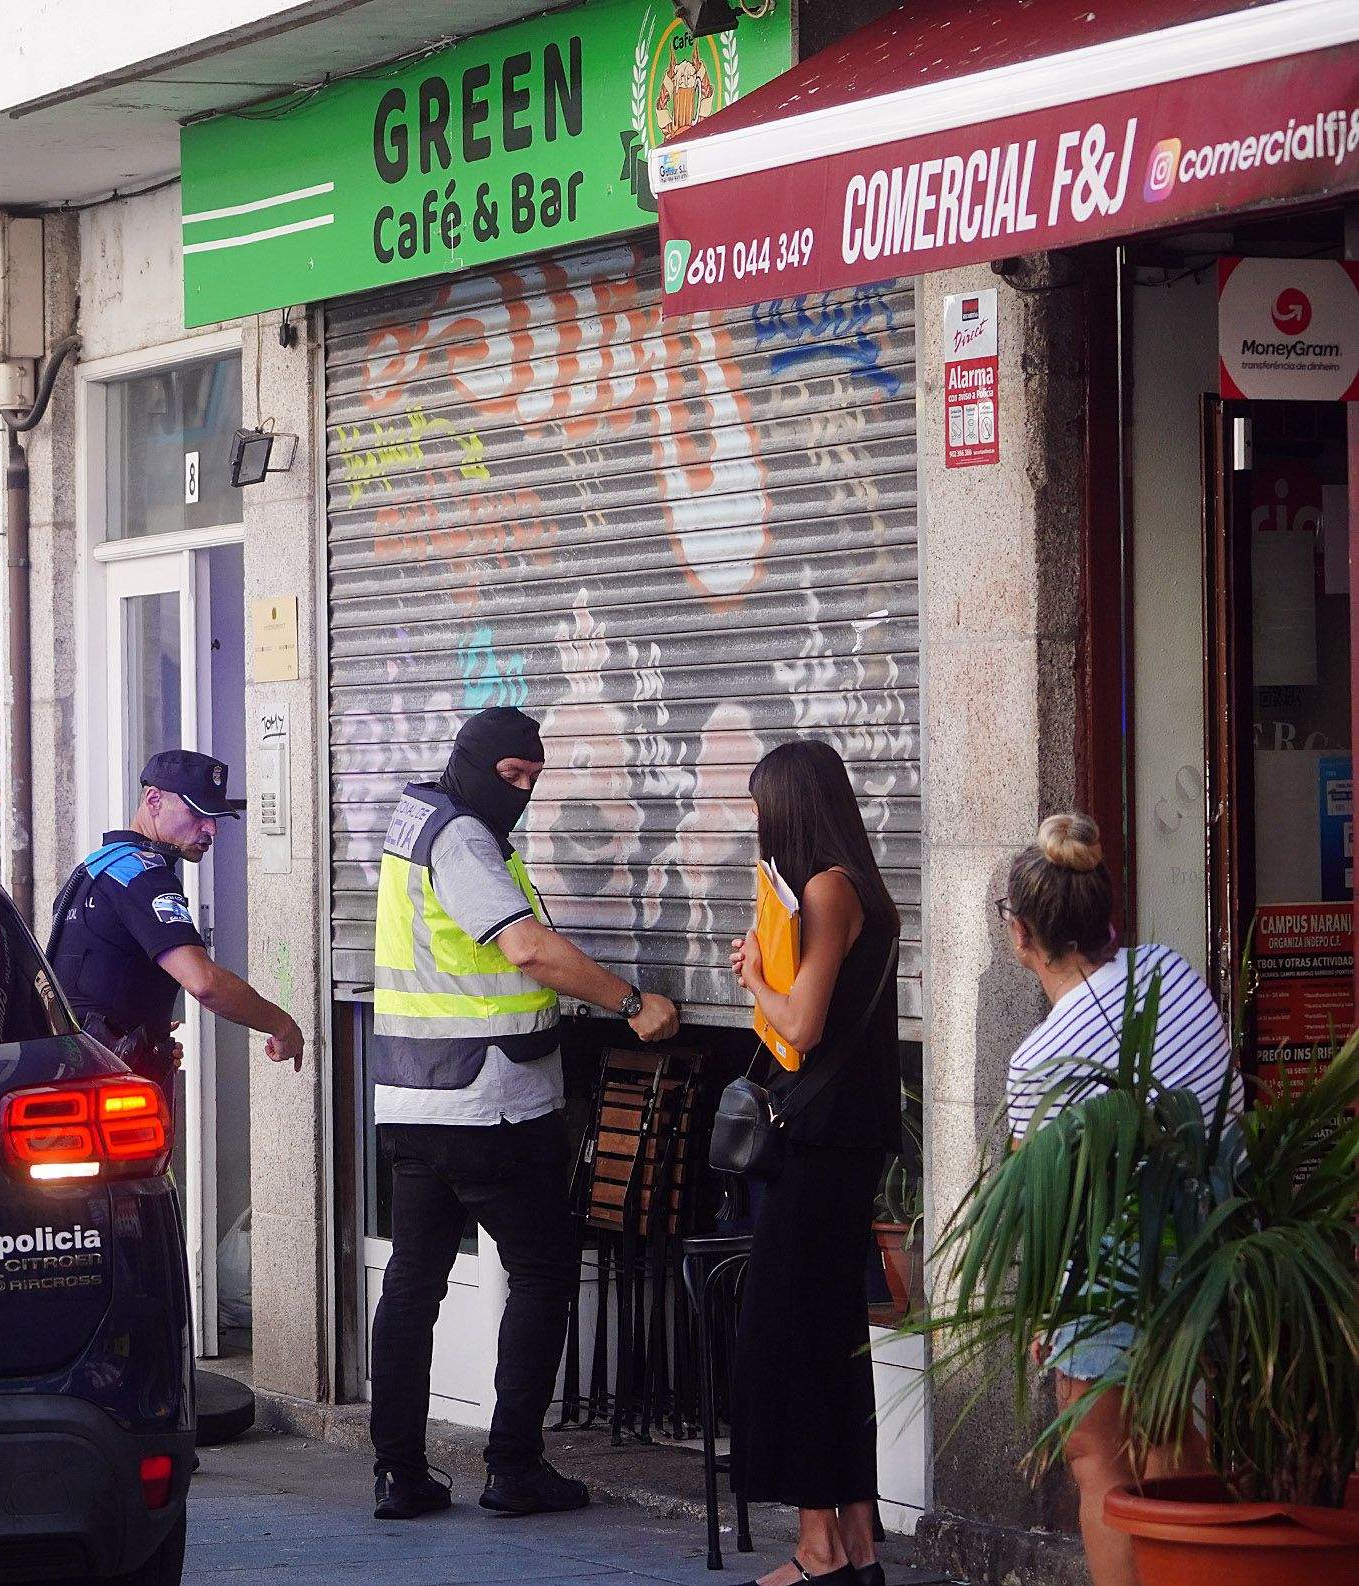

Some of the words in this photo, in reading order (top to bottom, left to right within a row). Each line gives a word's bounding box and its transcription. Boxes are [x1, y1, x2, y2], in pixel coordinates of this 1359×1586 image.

[373, 36, 583, 184] GREEN
[842, 139, 1038, 264] COMERCIAL
[1047, 117, 1138, 227] F&J
[373, 179, 462, 264] Café
[472, 182, 500, 242] &
[511, 171, 584, 234] Bar
[687, 245, 726, 285] 687
[733, 236, 770, 280] 044
[776, 227, 814, 271] 349
[1241, 340, 1340, 359] MoneyGram
[948, 366, 994, 389] Alarma
[189, 462, 196, 495] 8
[1261, 914, 1309, 934] CAMPUS
[1285, 957, 1311, 968] OTRAS
[1257, 1049, 1291, 1062] PRECO
[9, 1275, 103, 1291] AIRCROSS
